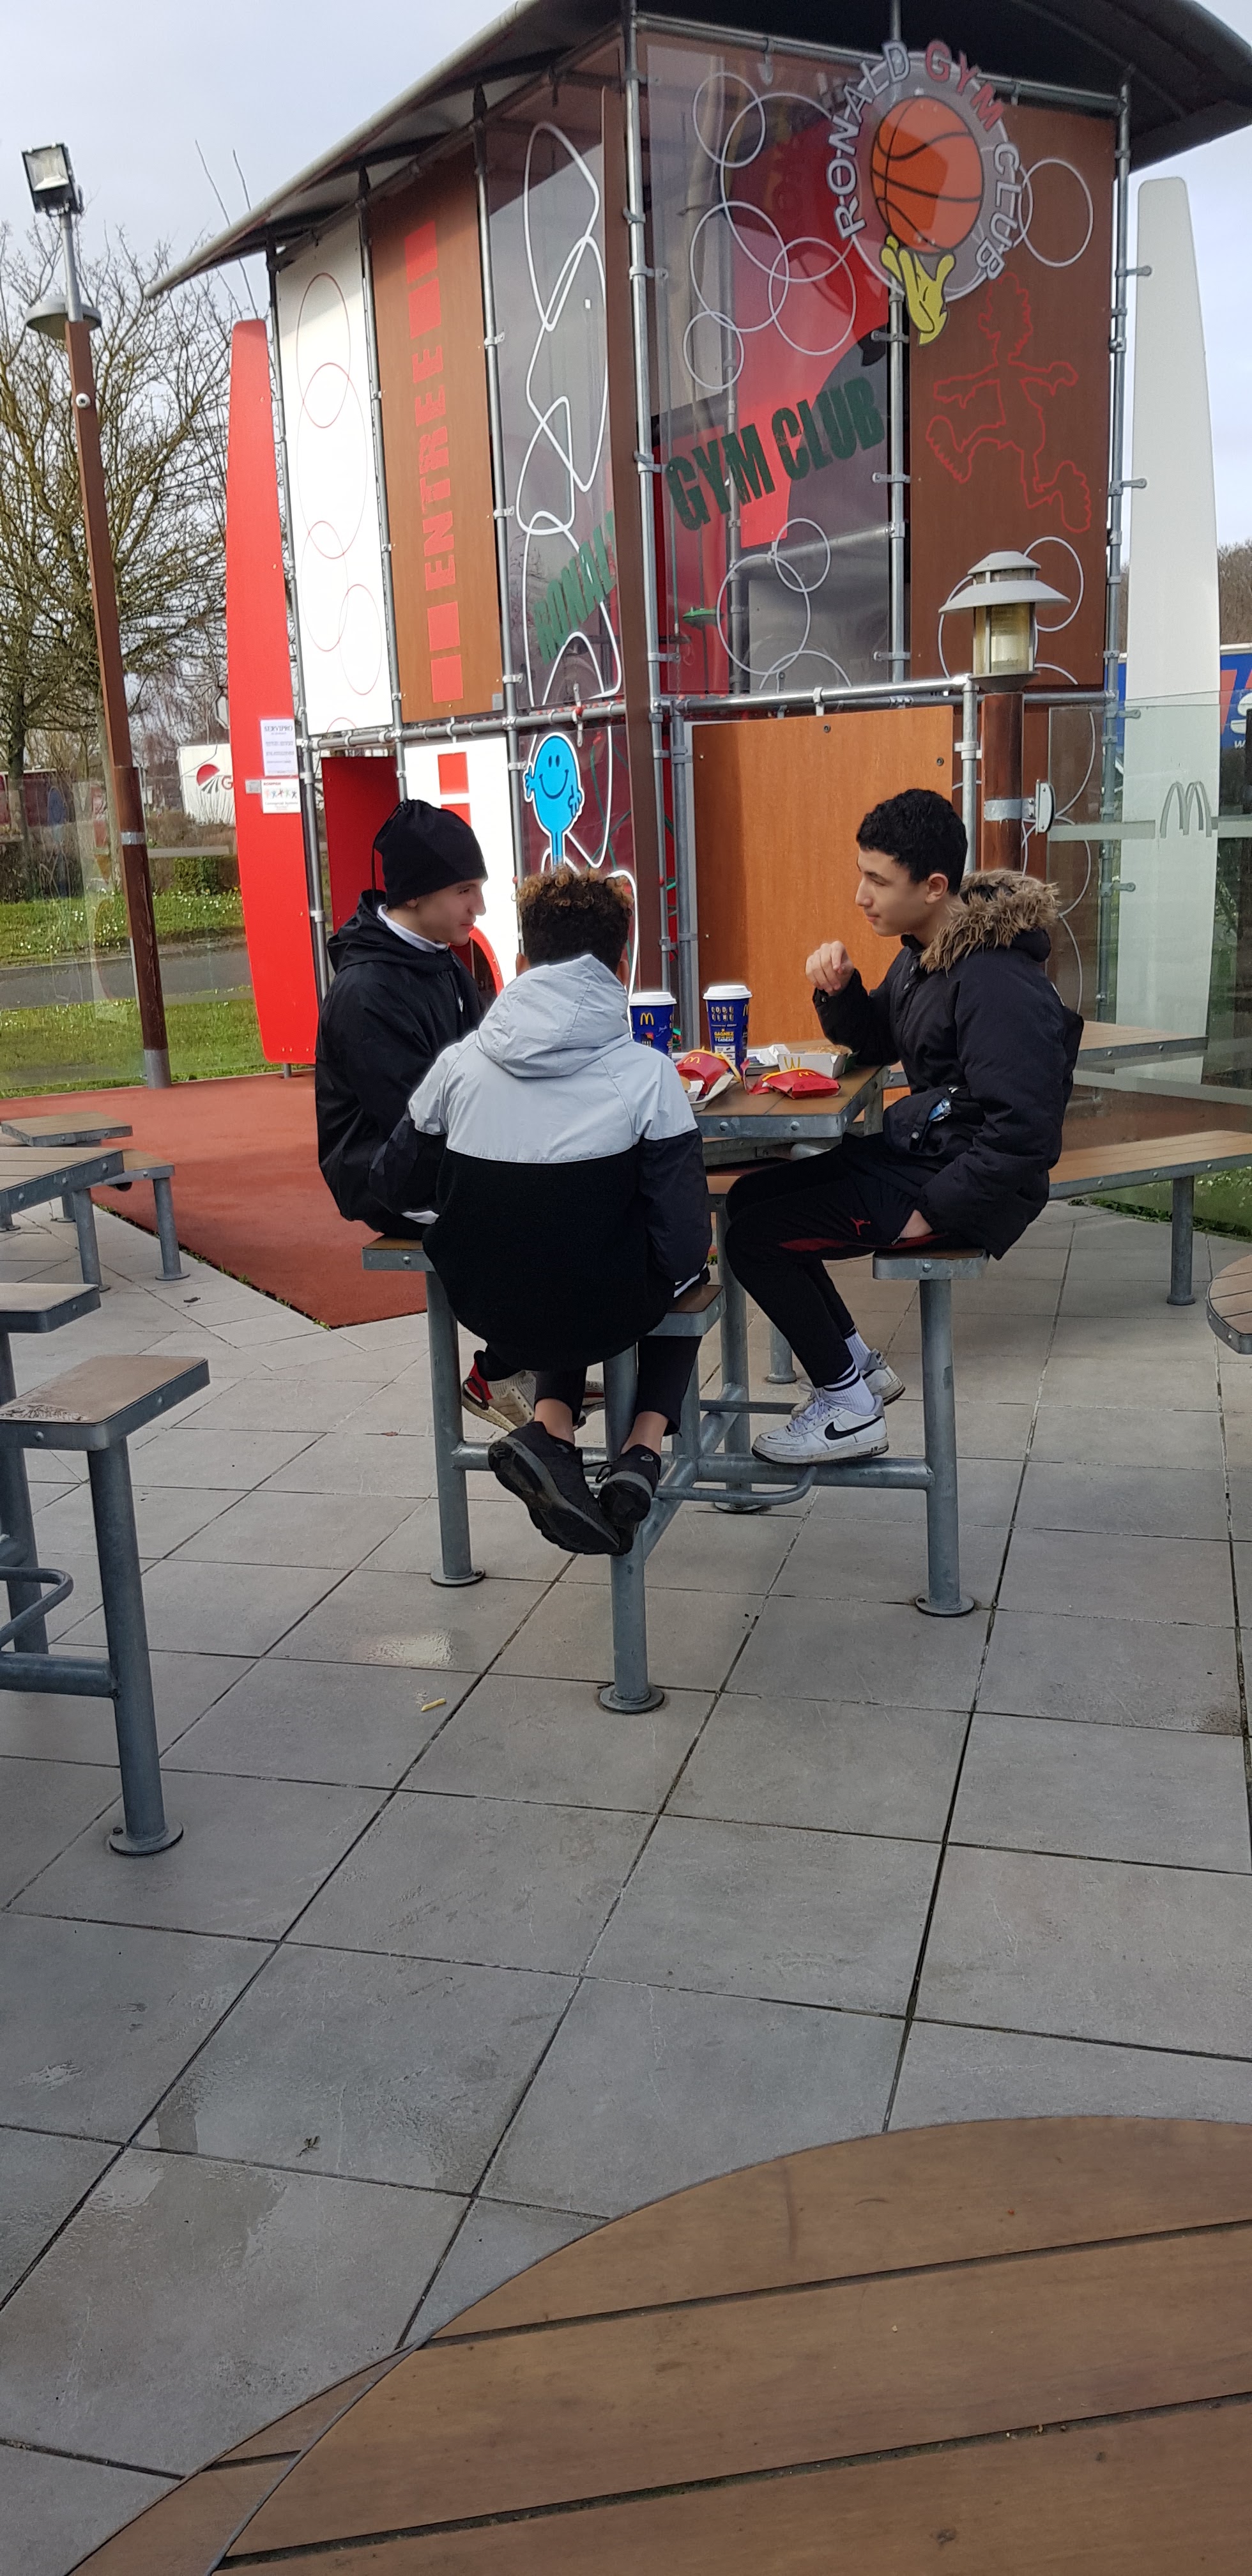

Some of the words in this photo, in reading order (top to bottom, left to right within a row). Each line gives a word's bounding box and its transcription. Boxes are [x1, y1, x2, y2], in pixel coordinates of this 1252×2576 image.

[826, 39, 910, 240] RONALD
[925, 38, 1005, 131] GYM
[975, 141, 1022, 280] CLUB
[412, 345, 457, 591] ENTREE
[665, 423, 776, 531] GYM
[772, 376, 886, 481] CLUB
[711, 1006, 734, 1015] CODE
